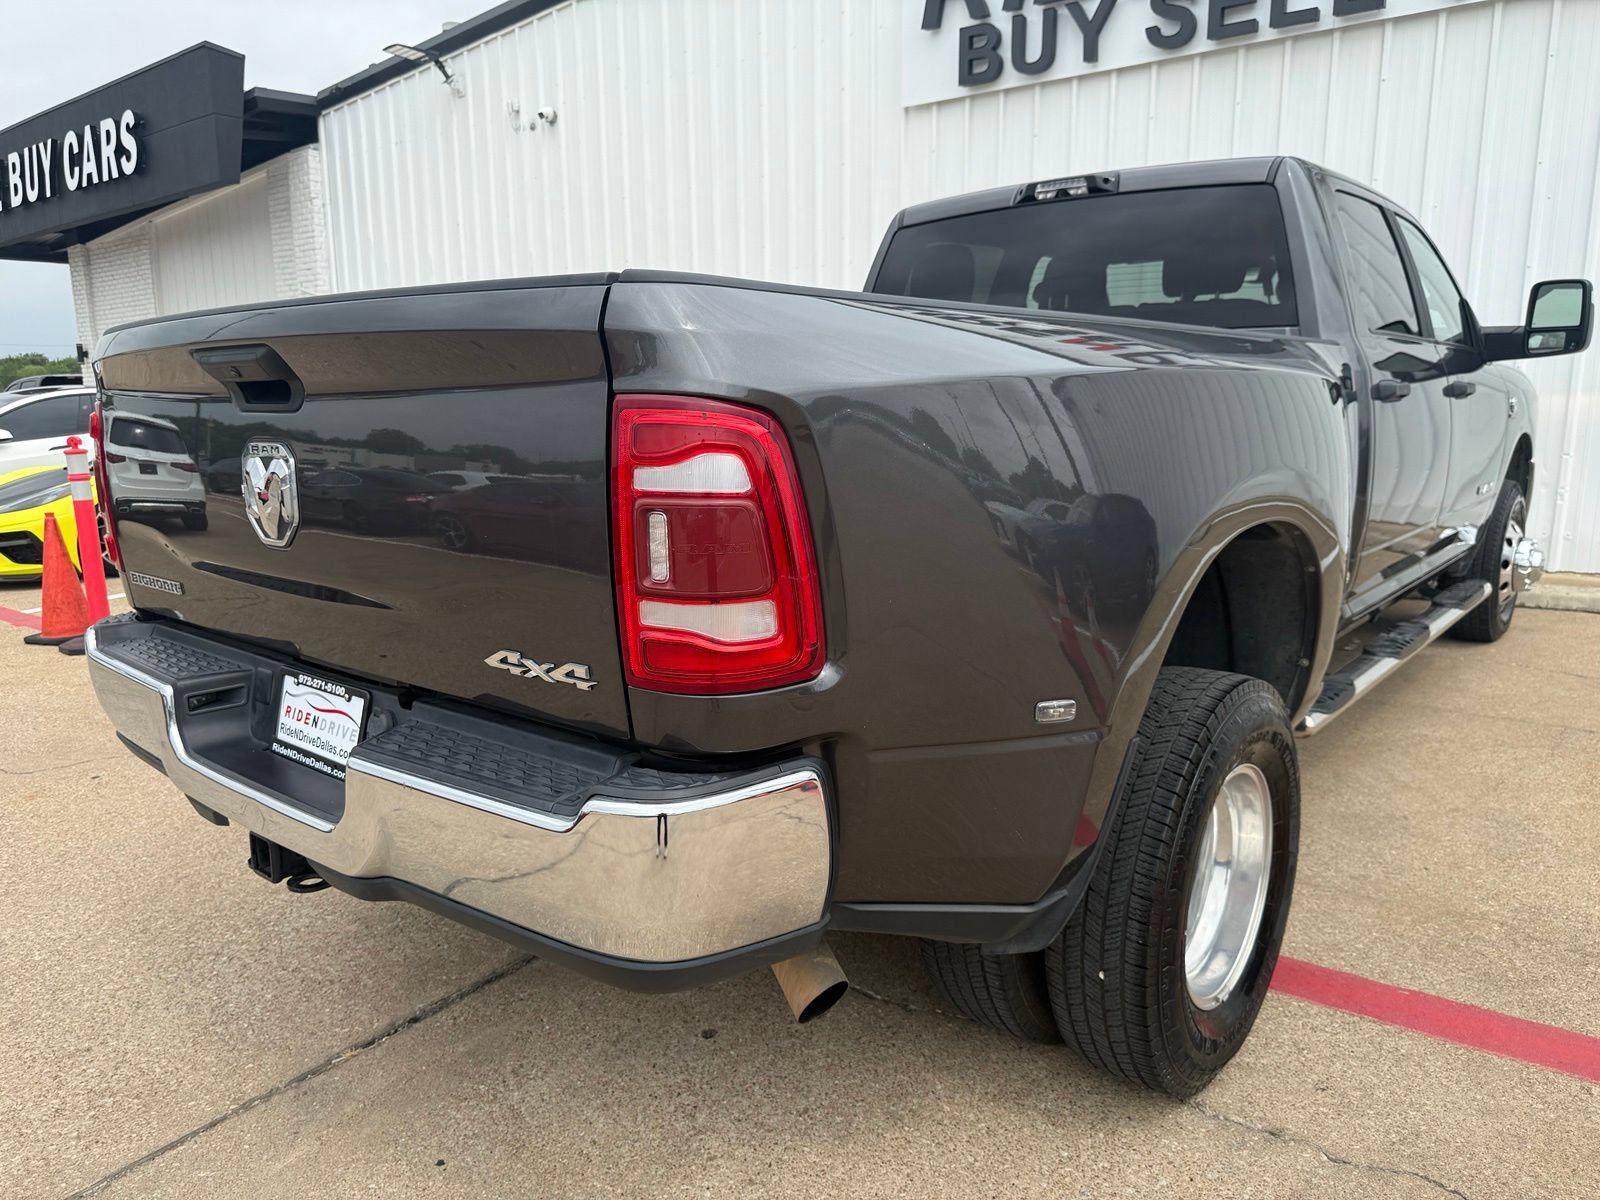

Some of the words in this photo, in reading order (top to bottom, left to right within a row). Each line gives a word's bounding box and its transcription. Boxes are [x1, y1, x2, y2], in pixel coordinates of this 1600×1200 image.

[959, 0, 1117, 87] BUY
[1145, 0, 1386, 49] SEL
[8, 138, 52, 208] BUY
[63, 109, 138, 191] CARS
[250, 445, 280, 454] RAM
[131, 573, 181, 594] BIGHORN
[298, 674, 346, 696] 972-271-5100
[280, 722, 350, 759] RideNDriveDallas.co
